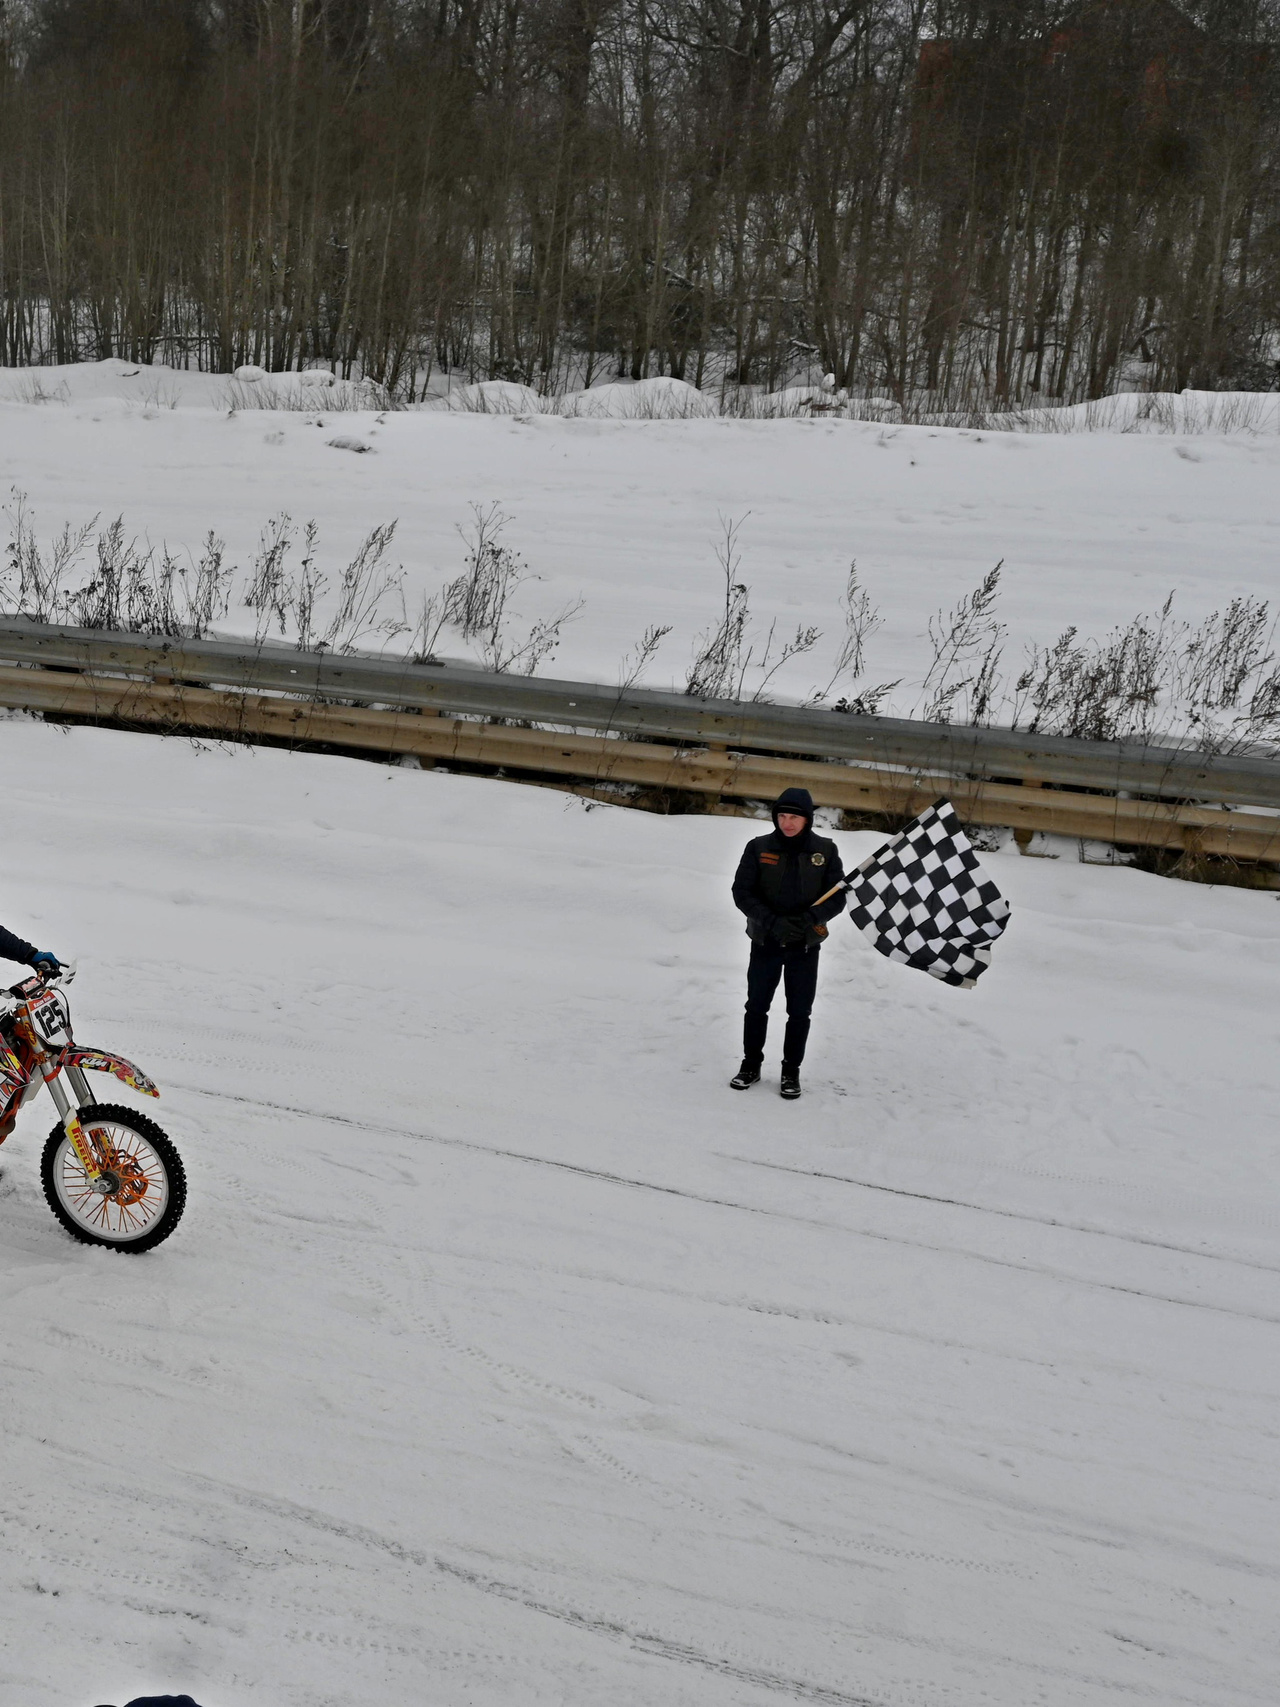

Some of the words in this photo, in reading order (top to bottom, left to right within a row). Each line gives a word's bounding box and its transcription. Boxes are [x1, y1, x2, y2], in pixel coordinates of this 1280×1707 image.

[34, 1000, 67, 1039] 125
[80, 1057, 108, 1067] KTM
[71, 1126, 98, 1174] PIRELLI
